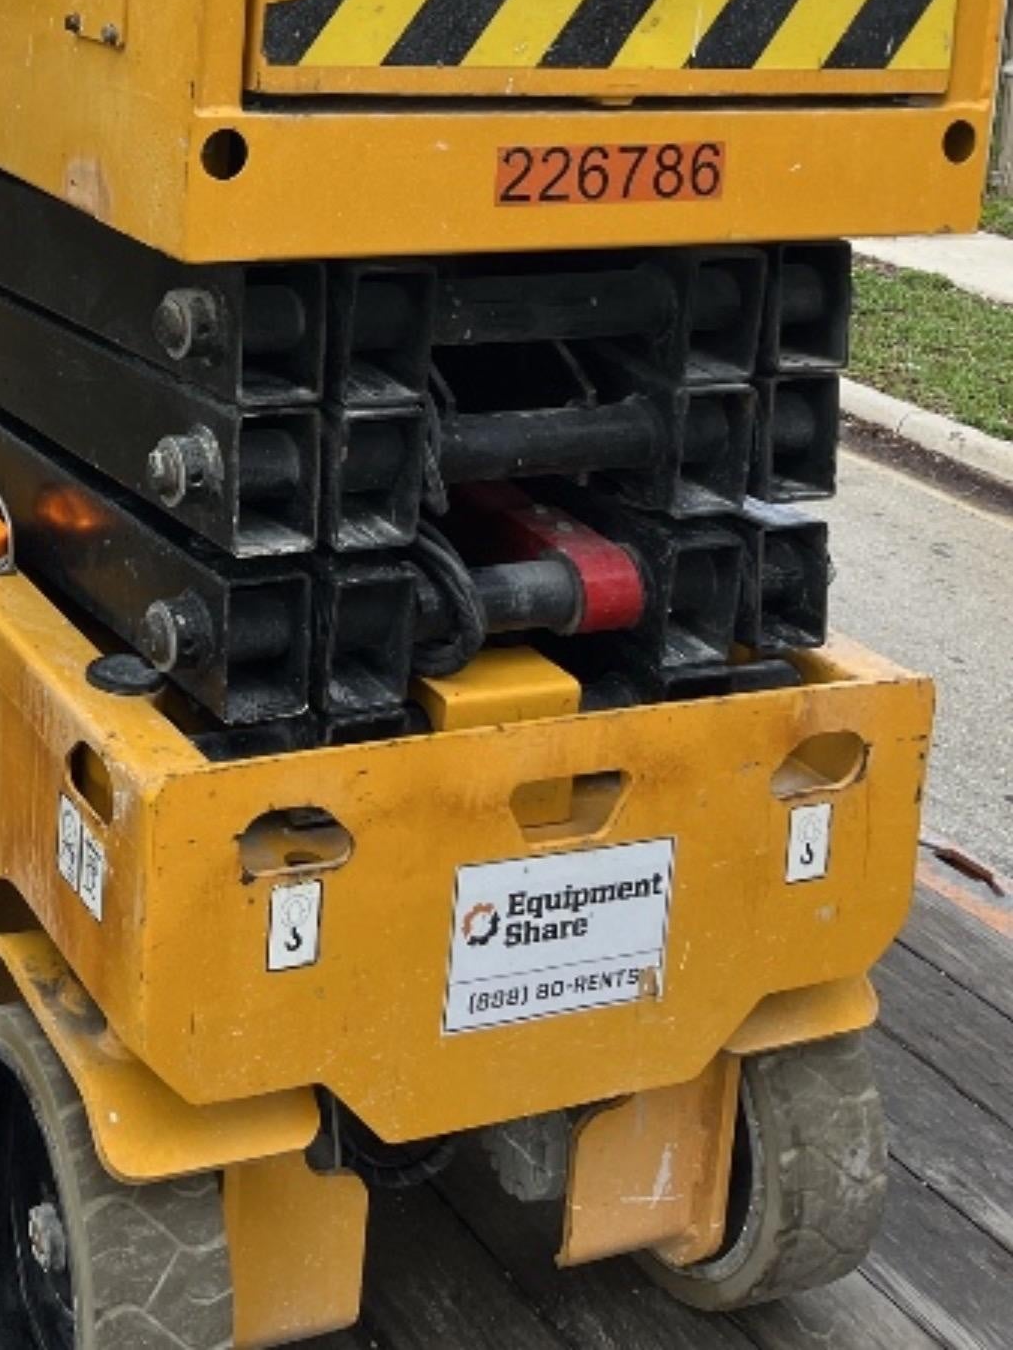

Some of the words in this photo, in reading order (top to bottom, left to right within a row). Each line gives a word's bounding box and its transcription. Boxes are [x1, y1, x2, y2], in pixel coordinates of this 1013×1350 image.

[499, 142, 722, 202] 226786
[506, 872, 663, 919] Equipment
[504, 916, 588, 948] Share
